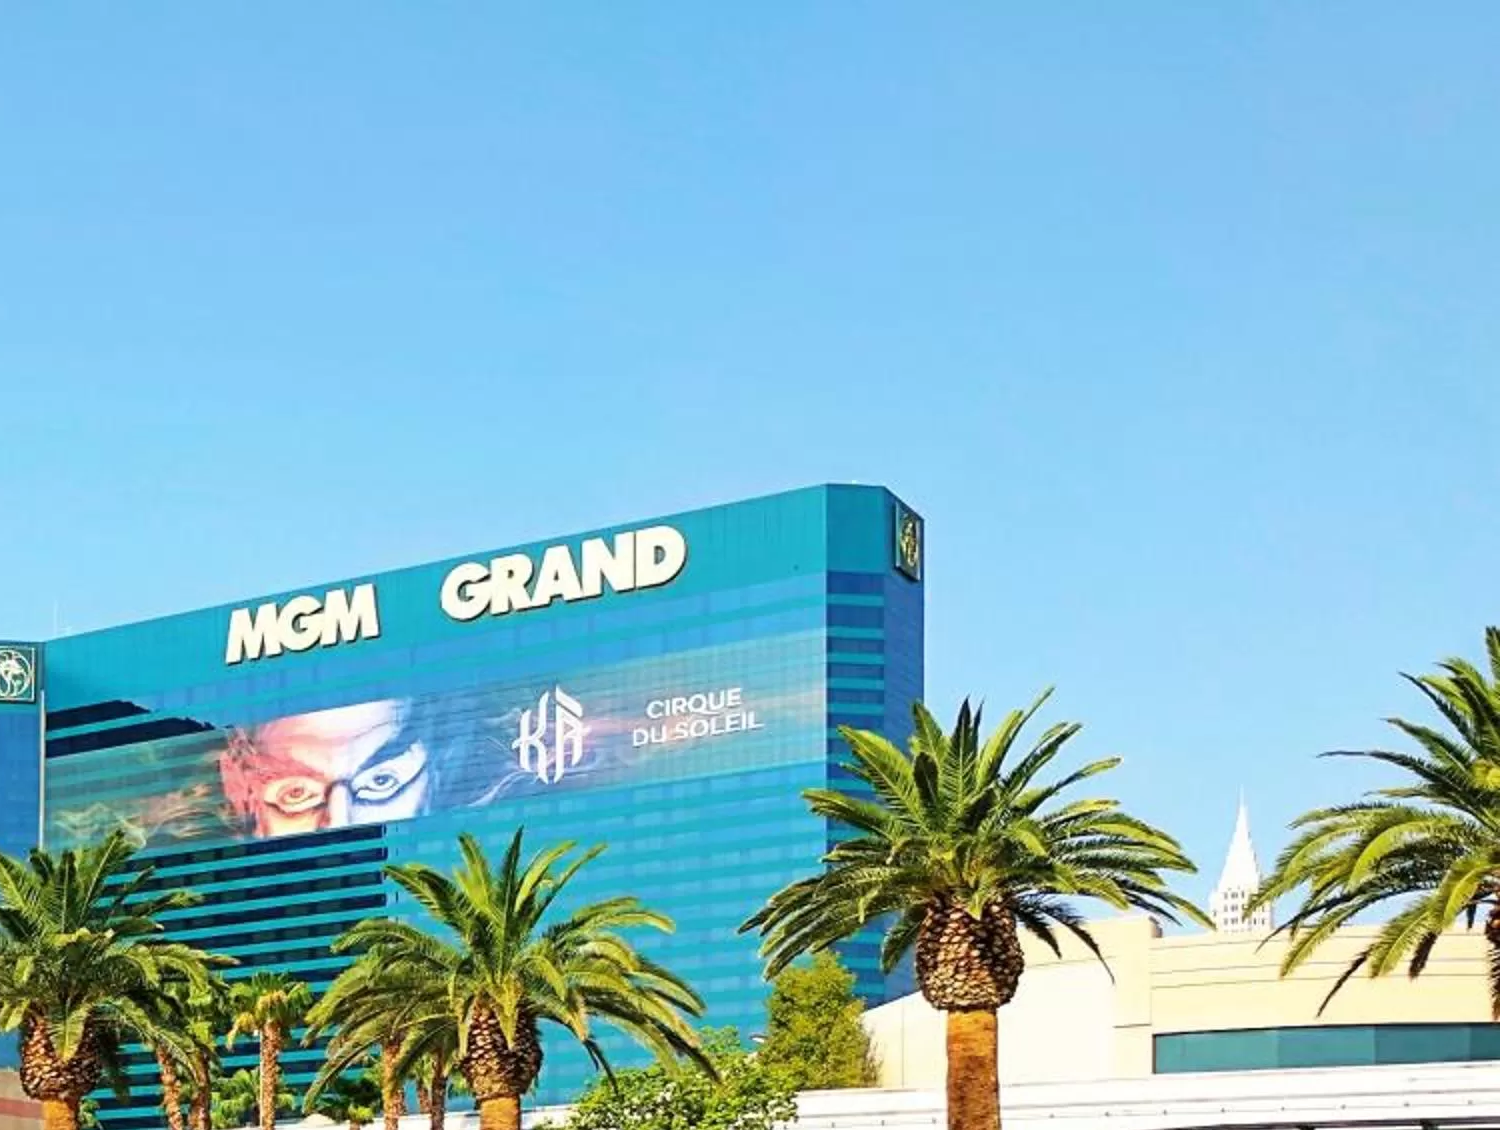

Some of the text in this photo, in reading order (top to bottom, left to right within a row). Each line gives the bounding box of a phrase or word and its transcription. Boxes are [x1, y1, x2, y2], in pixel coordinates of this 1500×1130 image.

[225, 525, 687, 664] MGM GRAND
[646, 687, 742, 719] CIRQUE
[632, 711, 765, 748] DU SOLEIL
